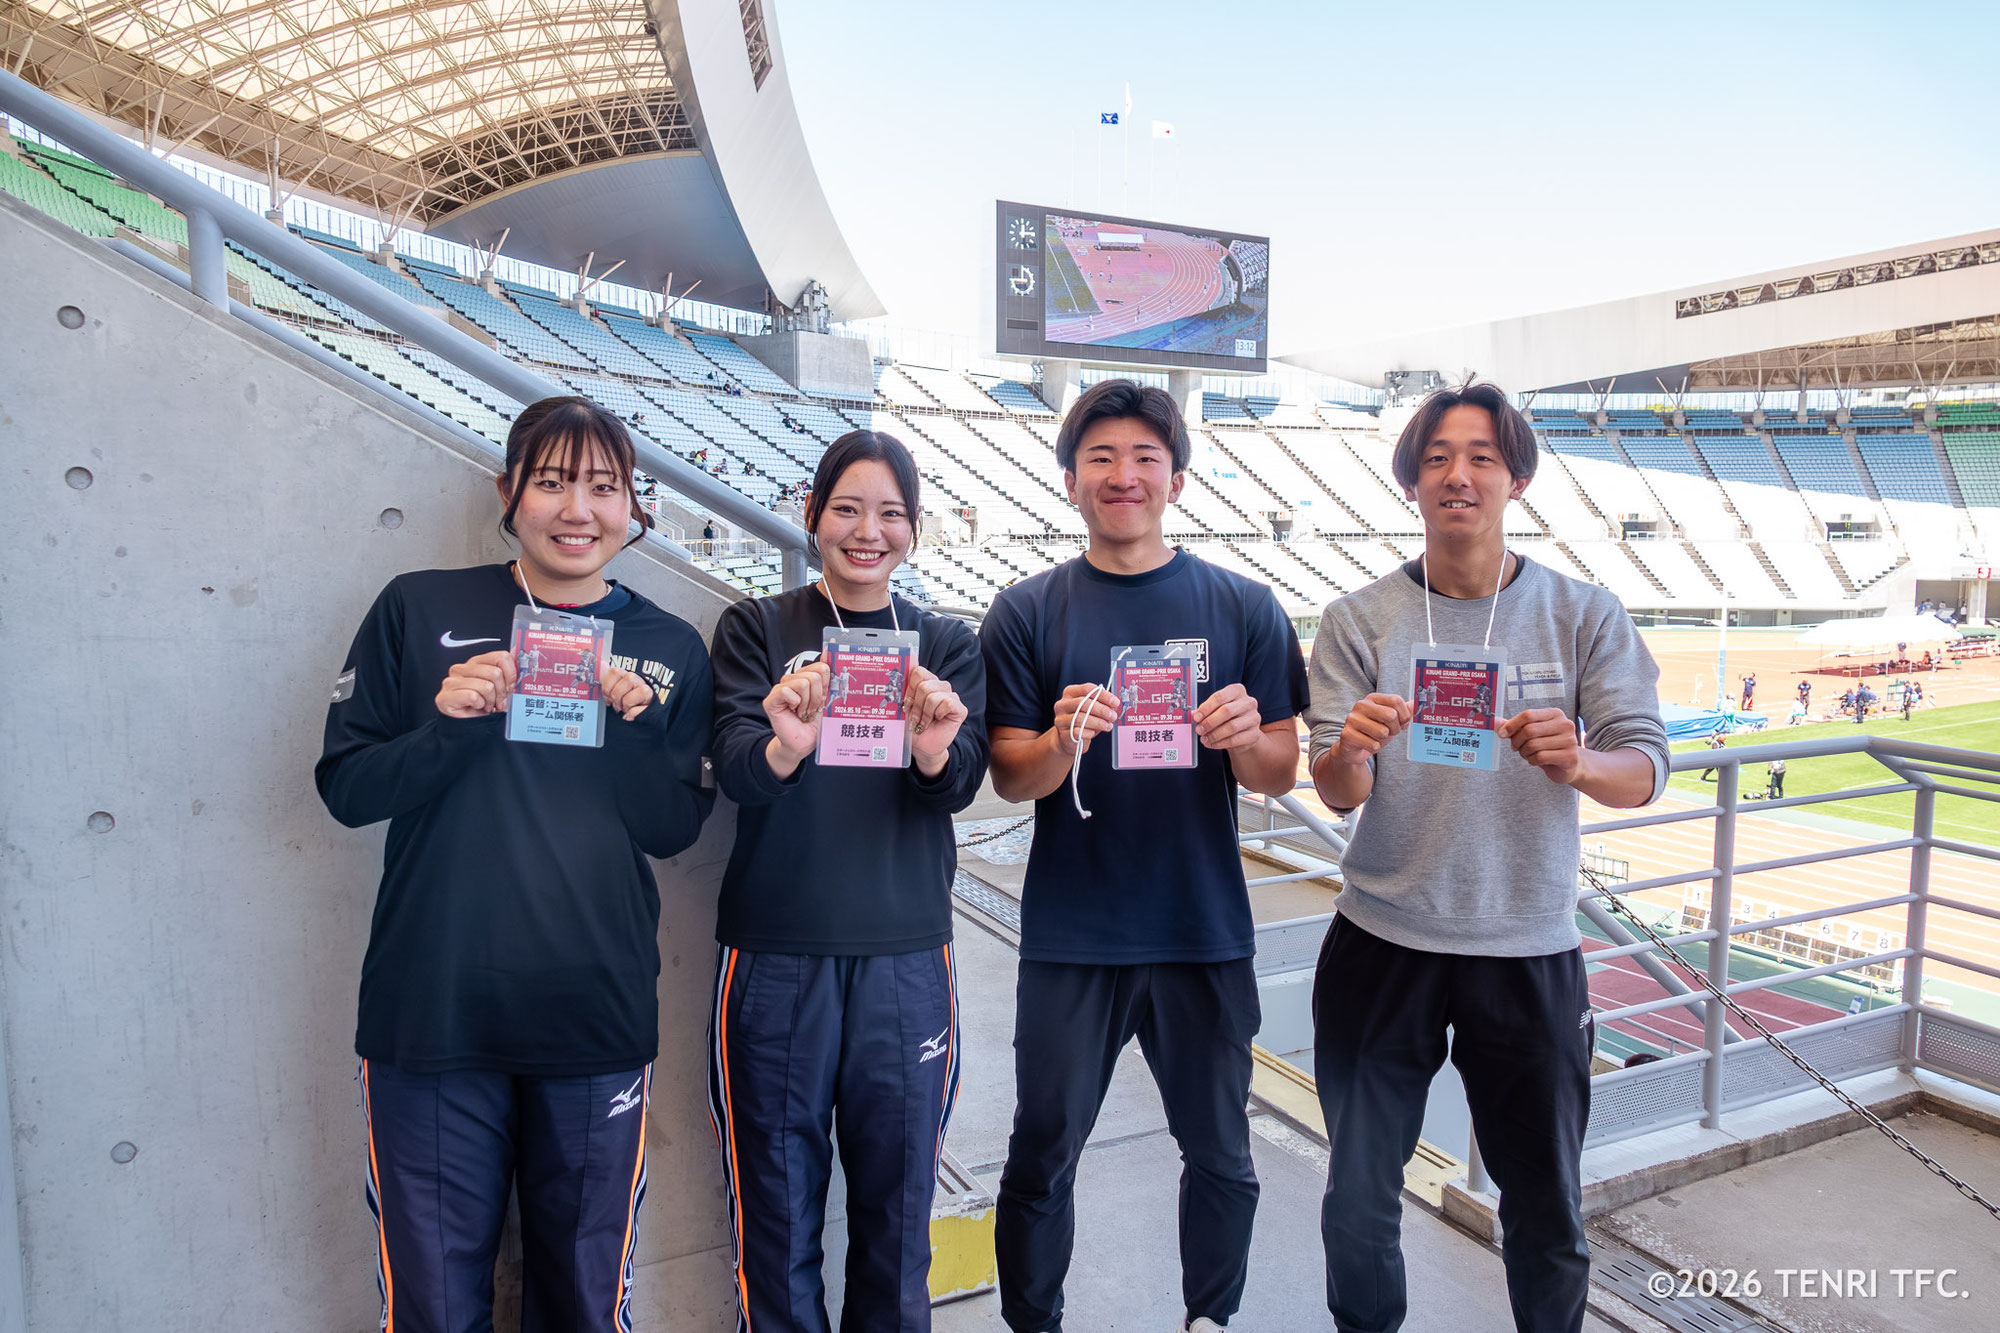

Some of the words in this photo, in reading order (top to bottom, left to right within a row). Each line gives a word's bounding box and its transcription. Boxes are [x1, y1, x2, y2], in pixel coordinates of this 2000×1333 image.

[1236, 341, 1255, 351] 13:12
[855, 655, 884, 663] GRAND-PRIX
[553, 662, 578, 674] GP
[609, 654, 638, 672] NRI
[642, 659, 675, 688] UNIV.
[1442, 670, 1471, 678] GRAND-PRIX
[863, 683, 888, 696] GP
[1151, 693, 1174, 703] GP
[1451, 696, 1474, 707] GP
[525, 709, 584, 722] チーム関係者
[840, 724, 886, 739] 競技者
[1134, 729, 1175, 742] 競技者
[1424, 735, 1480, 749] チーム関係者
[1743, 904, 1751, 914] 3
[1822, 924, 1831, 934] 6
[1851, 931, 1859, 941] 7
[1879, 938, 1889, 949] 8
